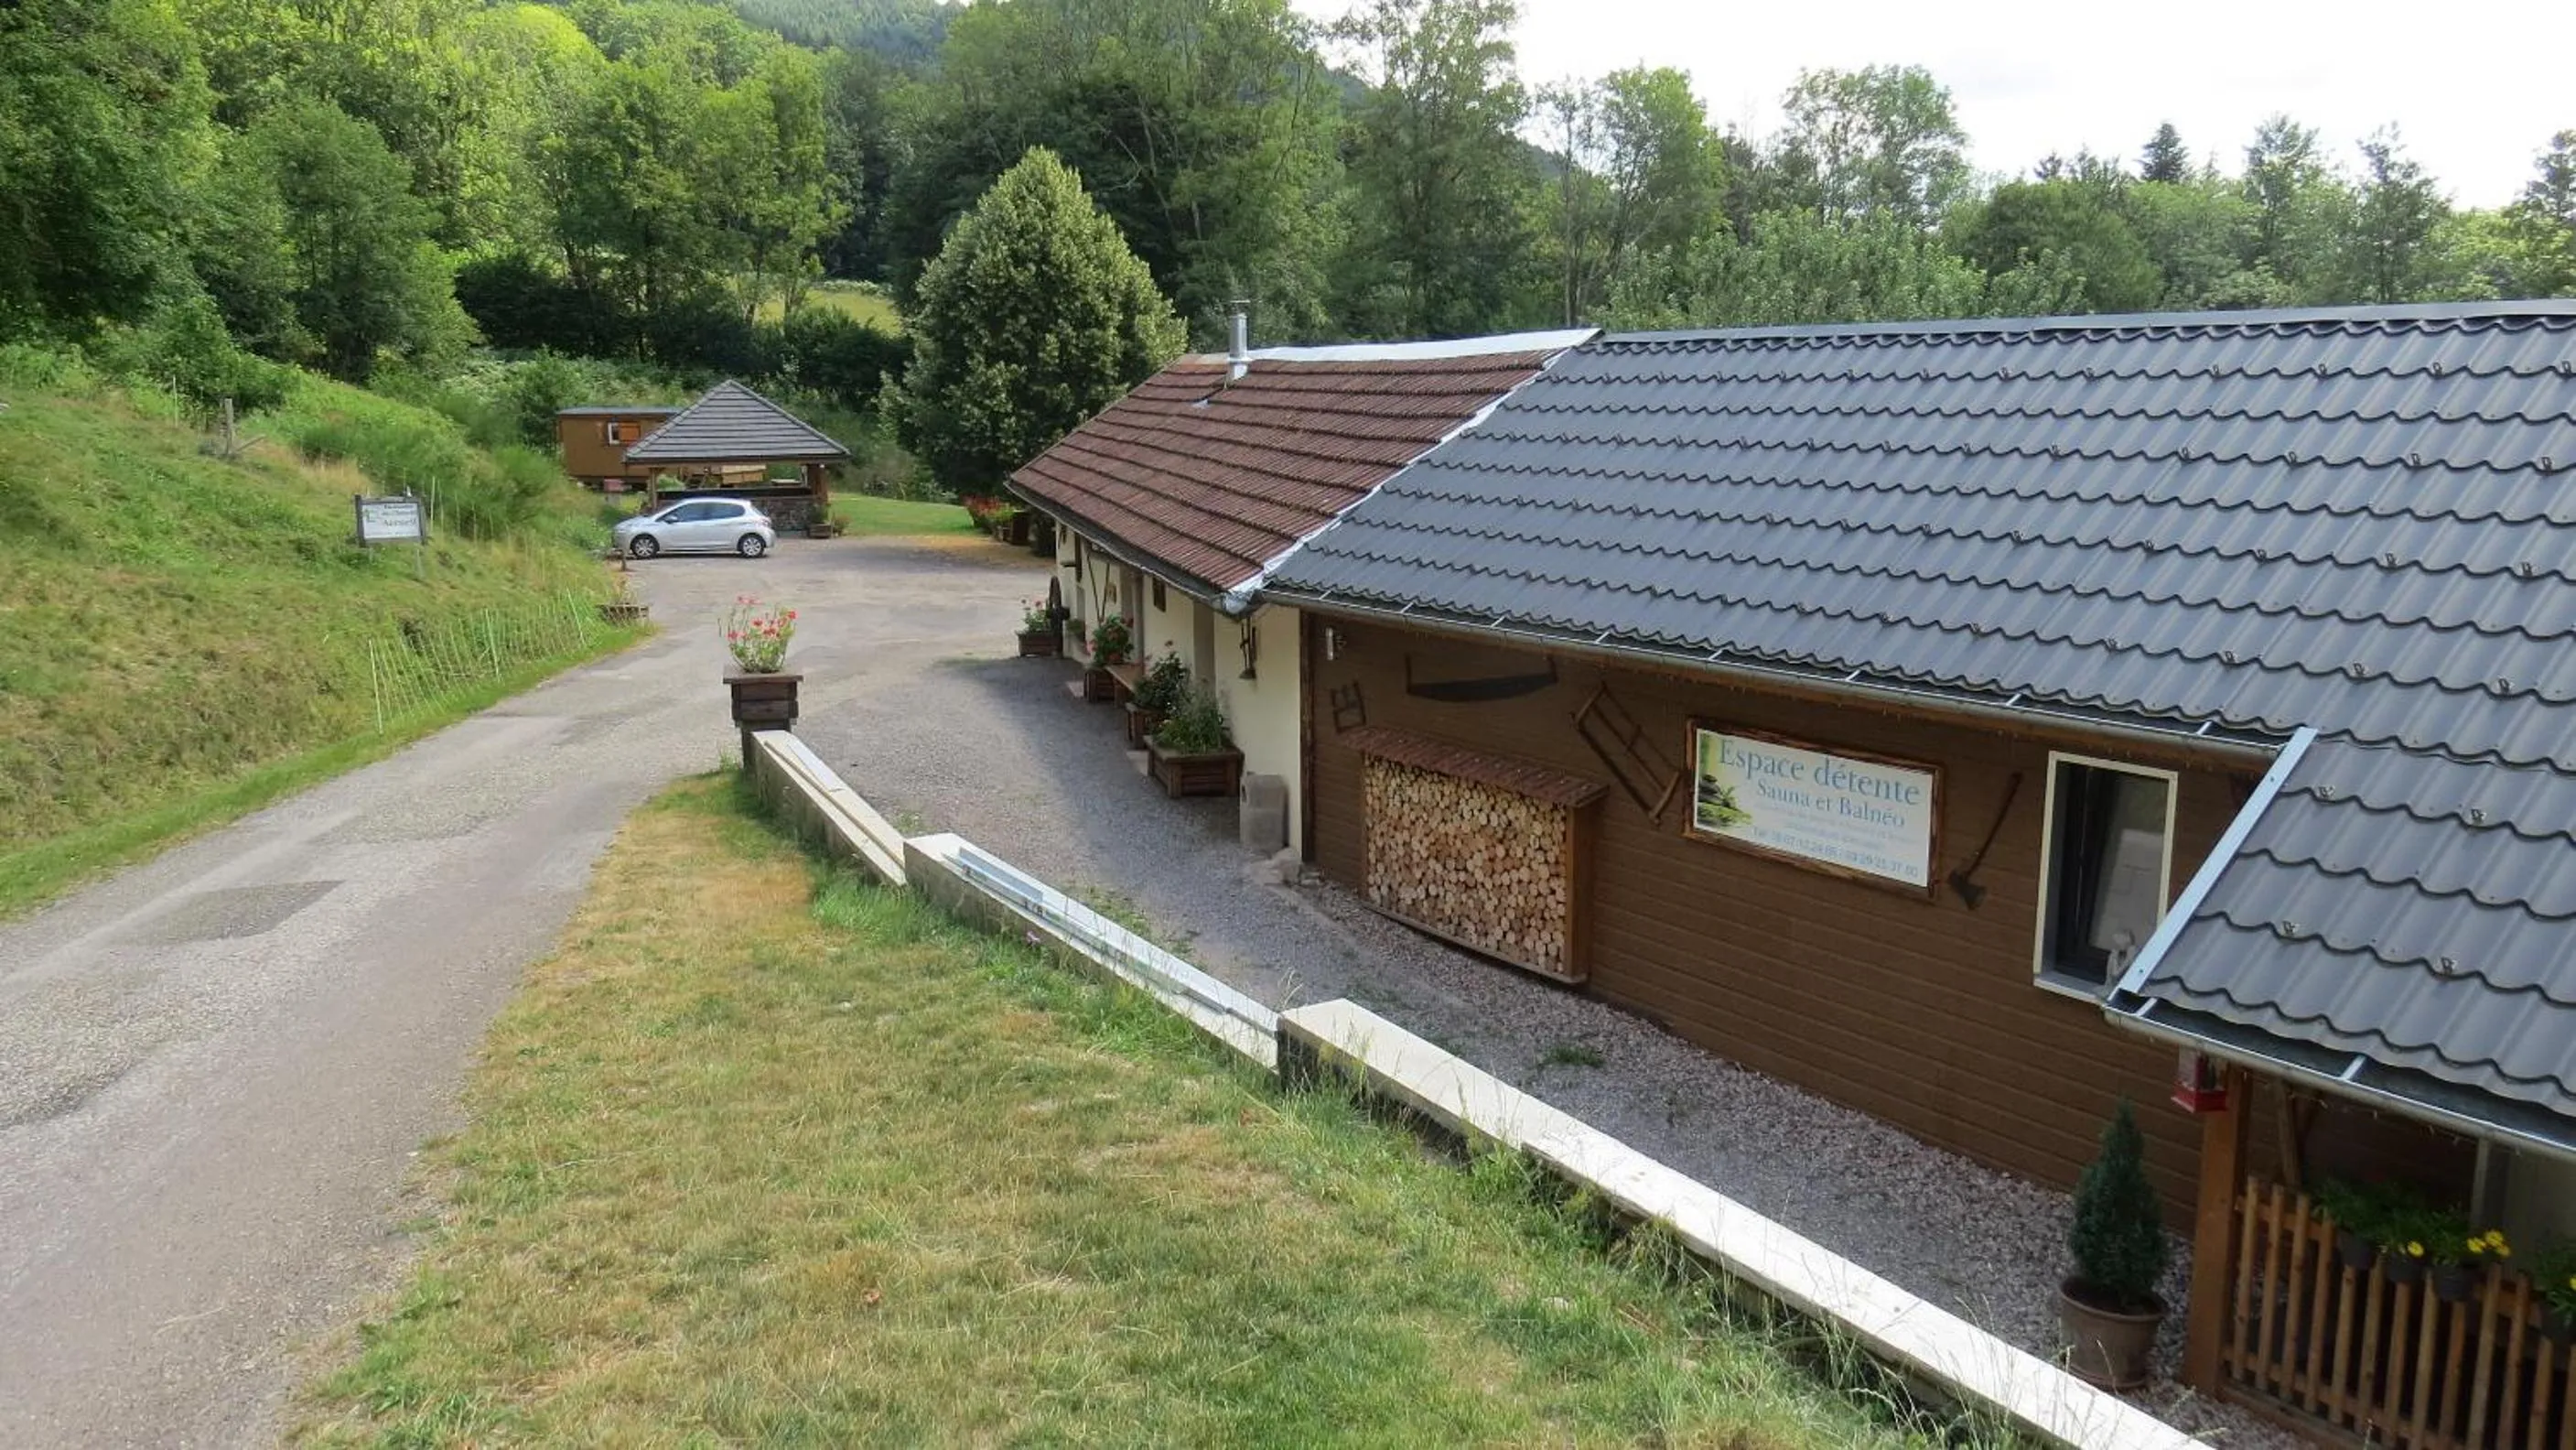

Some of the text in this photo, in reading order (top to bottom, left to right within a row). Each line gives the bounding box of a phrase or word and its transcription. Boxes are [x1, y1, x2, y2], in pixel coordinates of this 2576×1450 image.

[1719, 738, 1921, 806] Espace détente
[1756, 778, 1811, 808] Sauna
[1816, 795, 1832, 812] et
[1838, 796, 1905, 826] Balnéo
